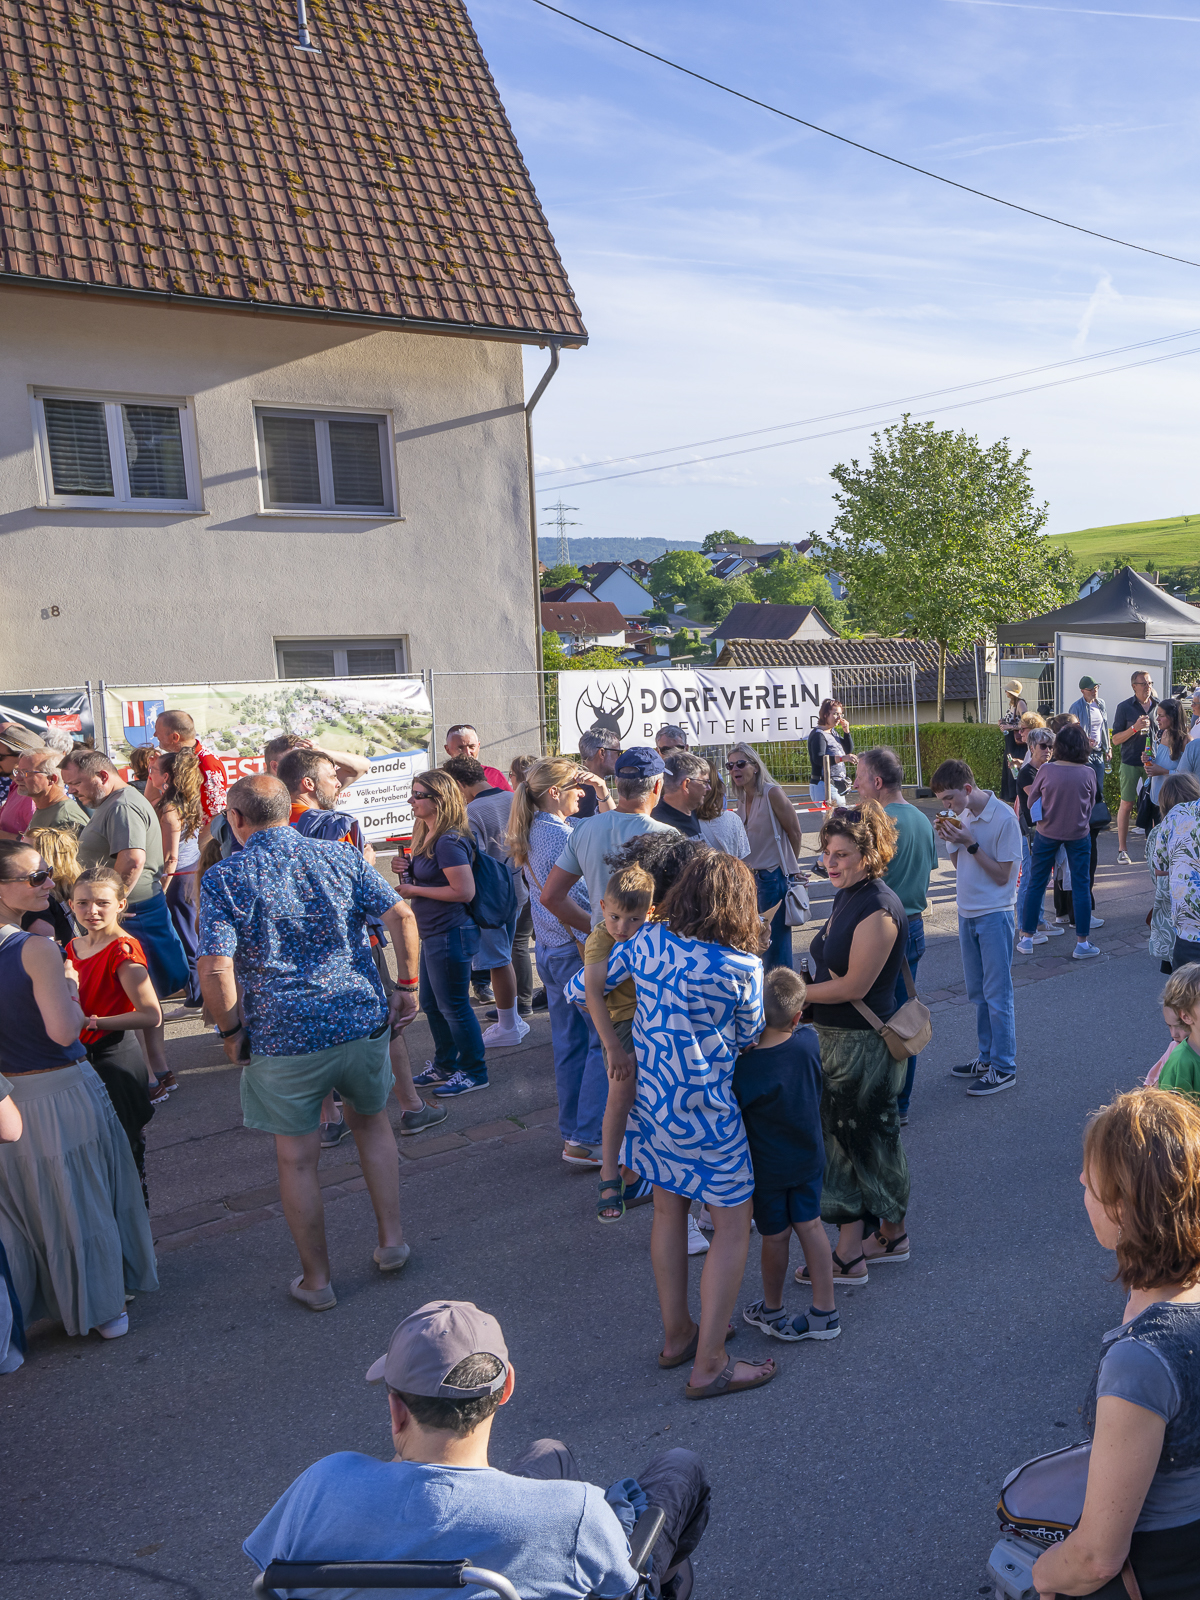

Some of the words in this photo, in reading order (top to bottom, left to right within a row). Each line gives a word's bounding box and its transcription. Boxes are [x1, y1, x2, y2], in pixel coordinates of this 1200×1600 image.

[51, 605, 60, 617] 8
[640, 683, 820, 714] DORFVEREIN
[364, 759, 406, 775] renade
[338, 791, 351, 799] TAG
[356, 783, 412, 797] Völkerball-Turnie
[363, 797, 370, 805] &
[370, 792, 408, 804] Partyabend
